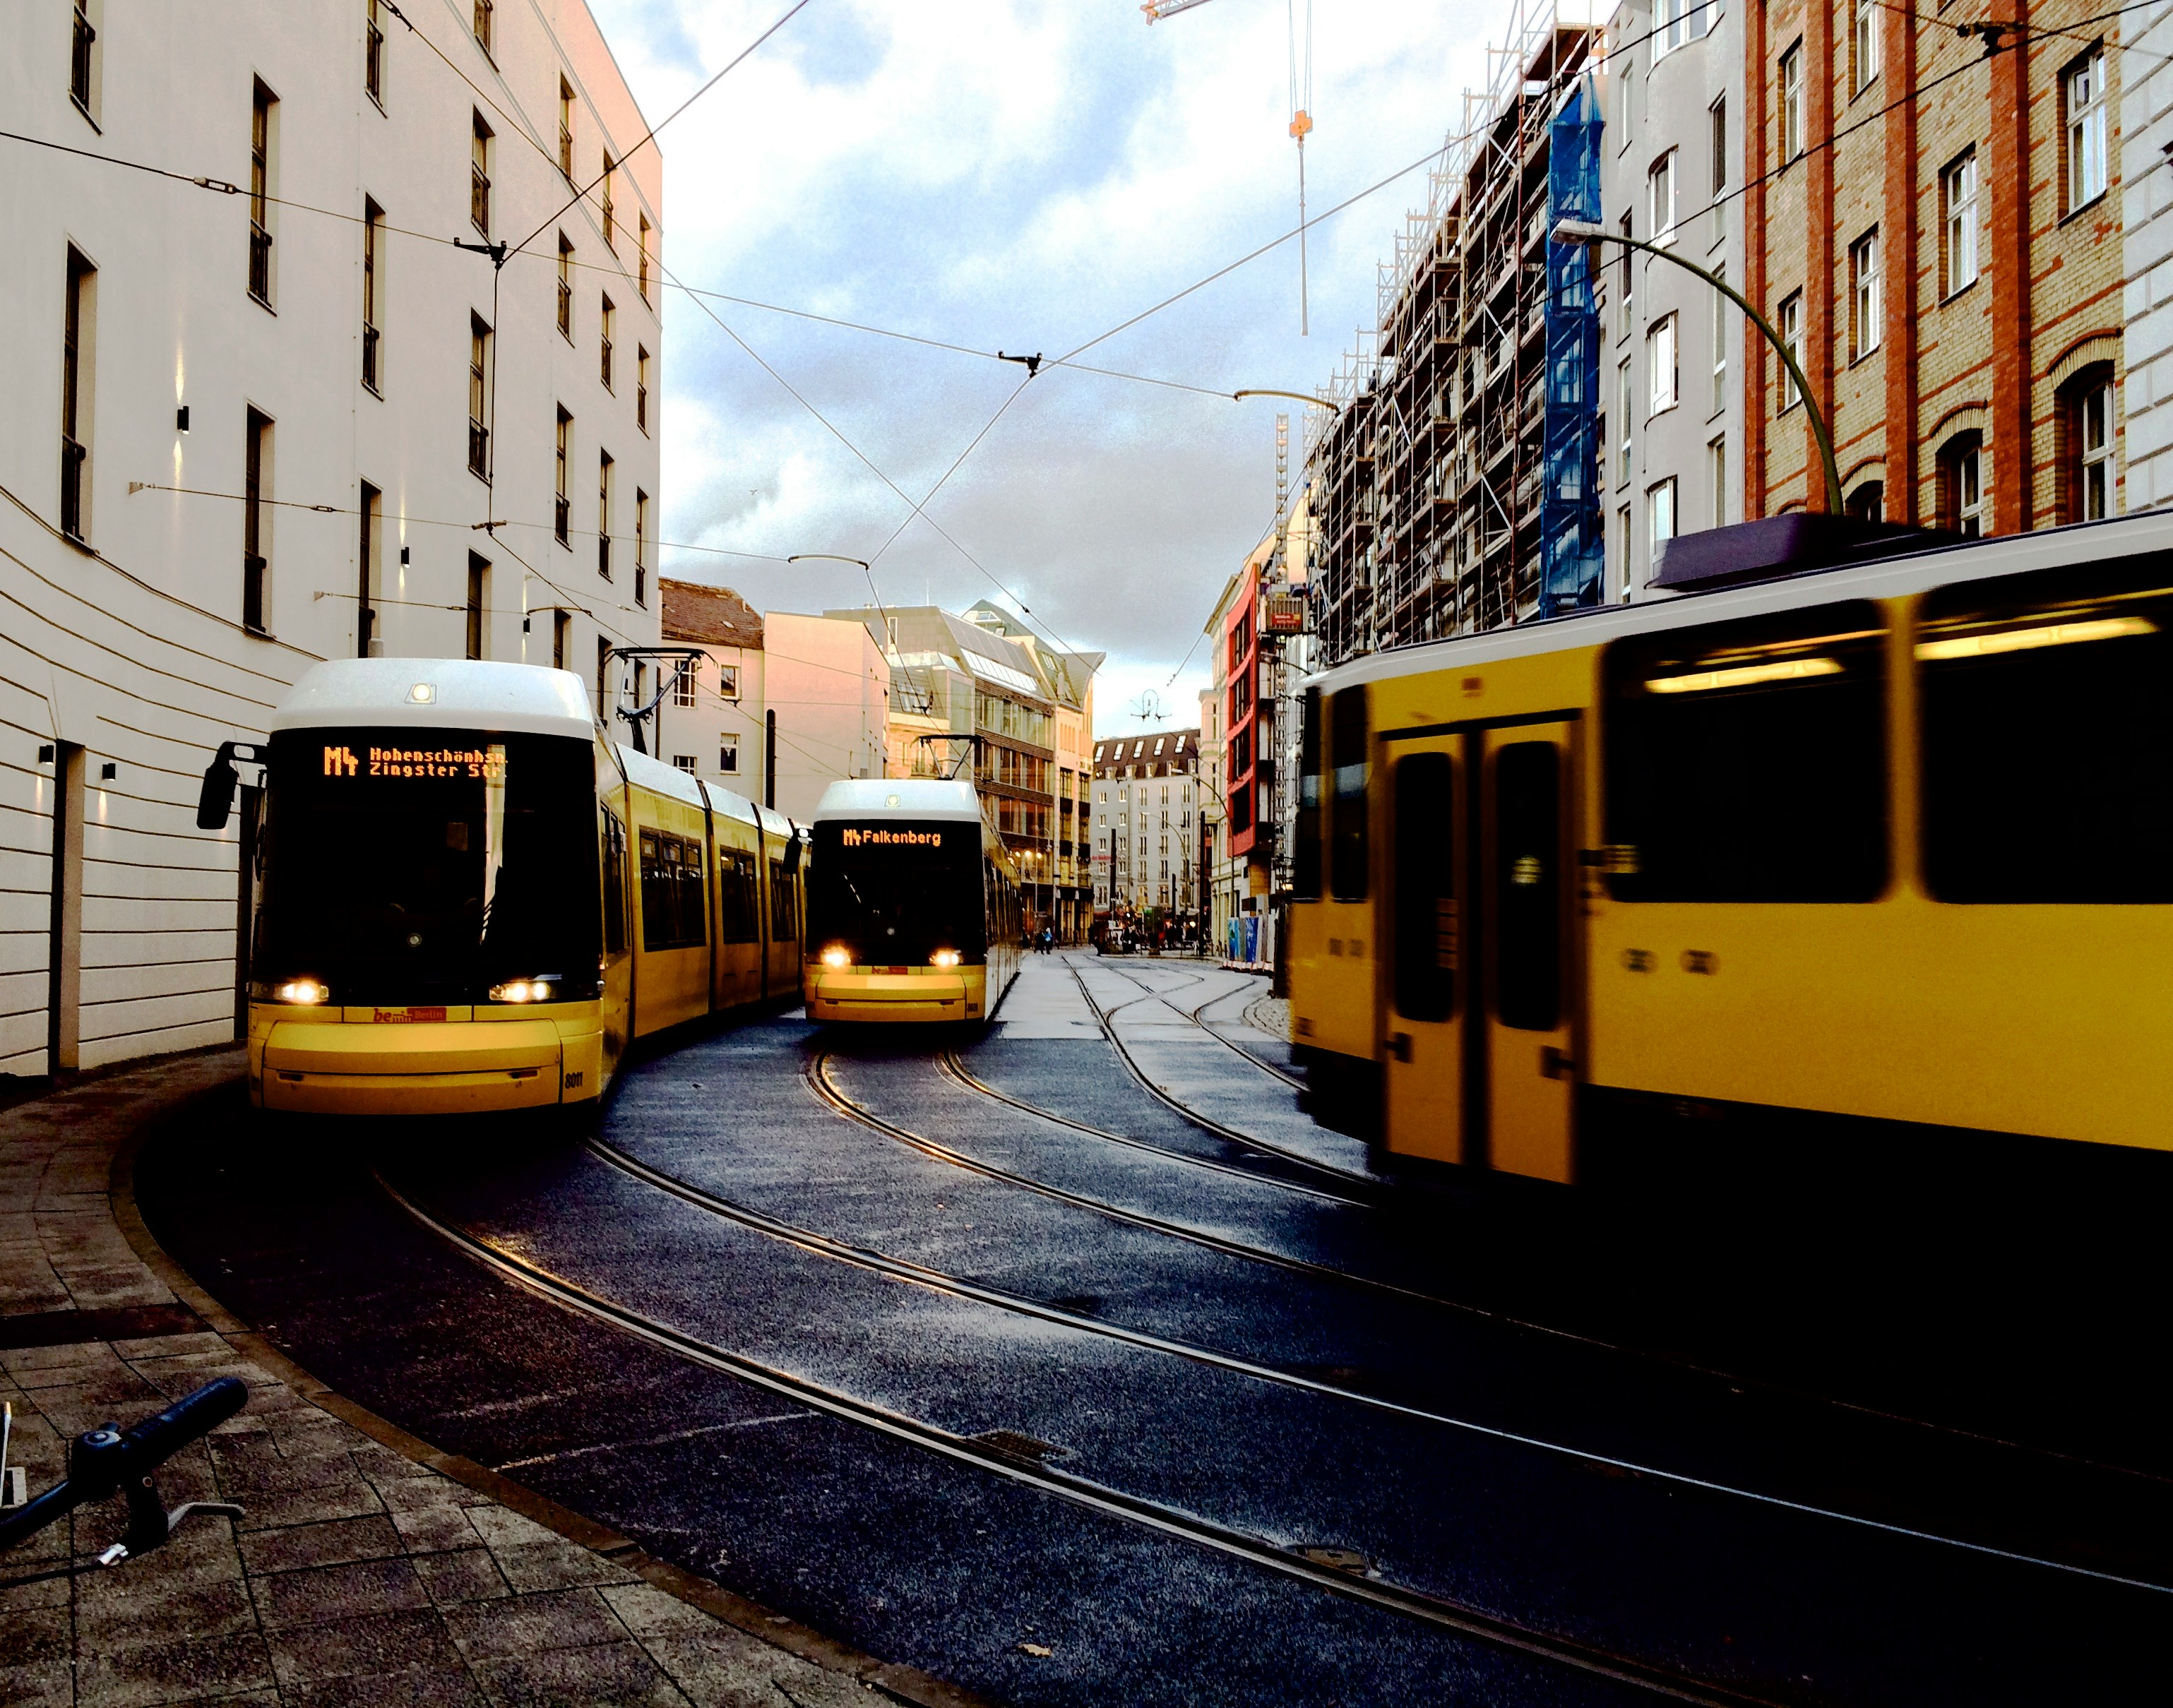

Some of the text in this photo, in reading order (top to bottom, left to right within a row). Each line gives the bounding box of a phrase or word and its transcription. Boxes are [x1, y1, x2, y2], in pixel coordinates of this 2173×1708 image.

[324, 746, 359, 776] M4
[370, 763, 459, 777] Zingster
[843, 829, 941, 847] M4 Falkenberg
[373, 1008, 443, 1022] be Berlin
[565, 1071, 583, 1089] 8011
